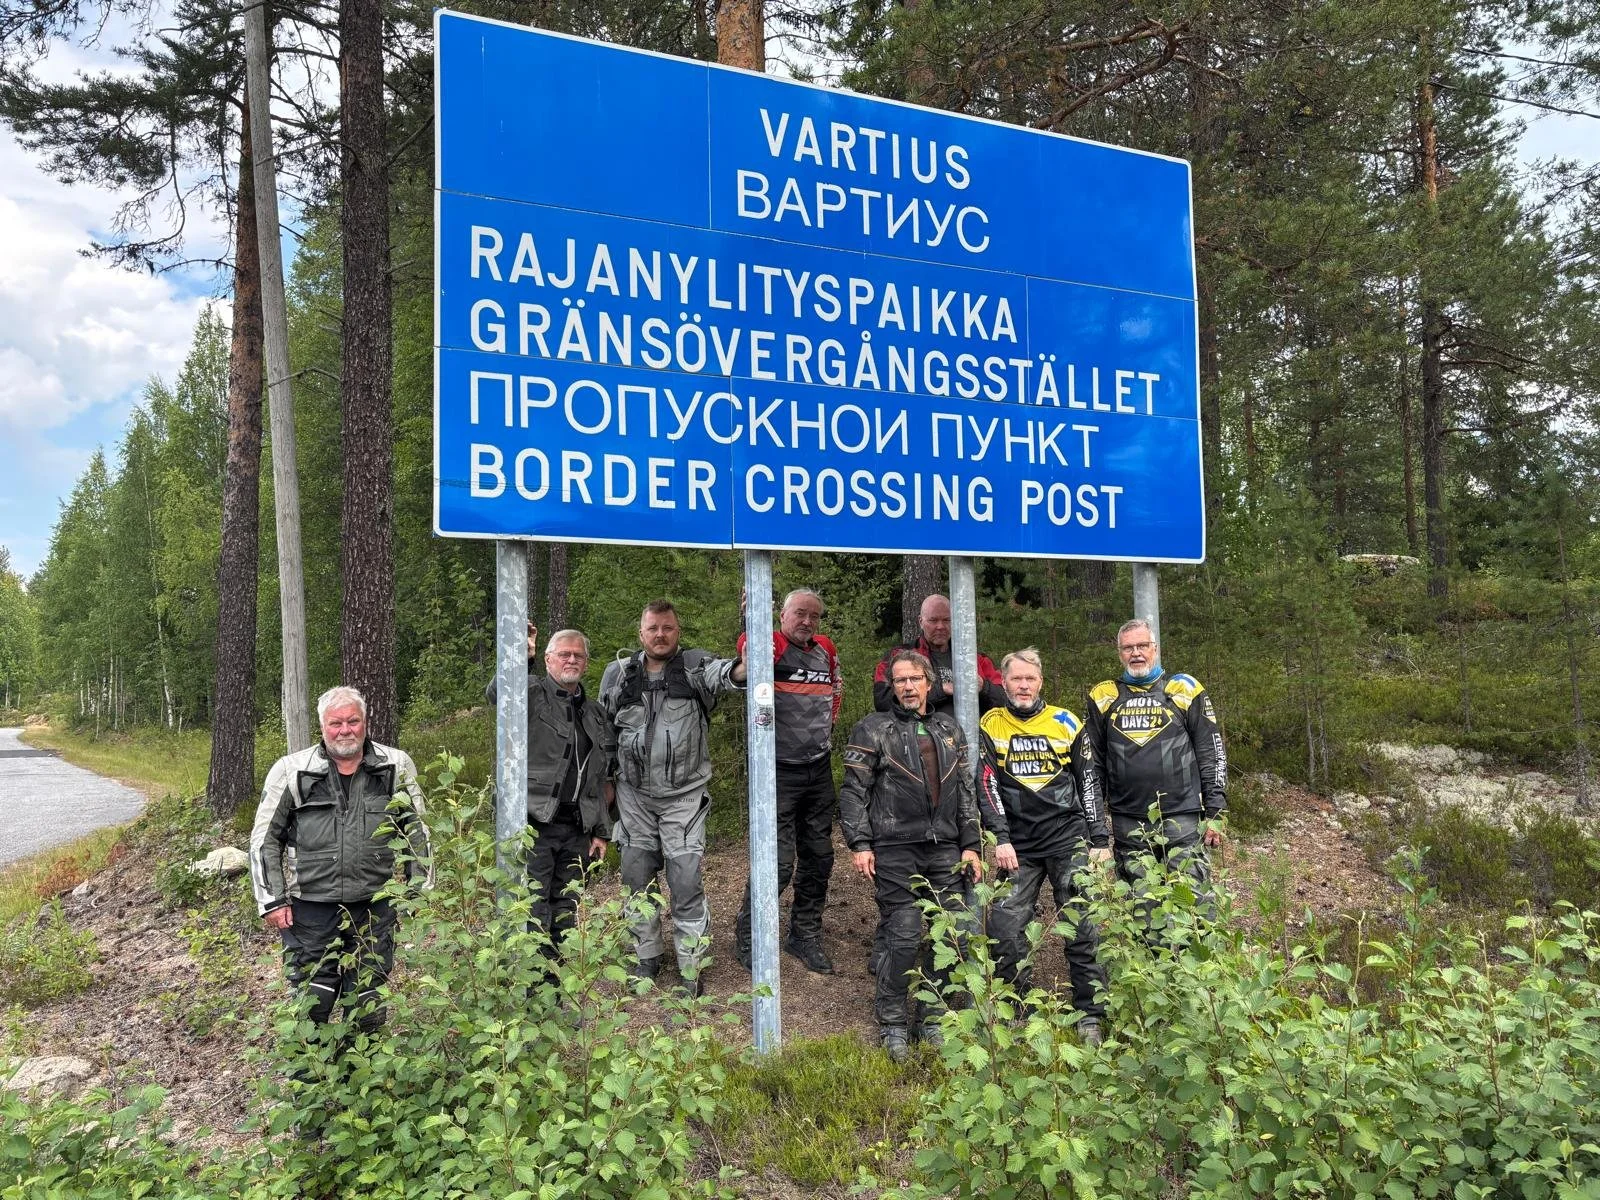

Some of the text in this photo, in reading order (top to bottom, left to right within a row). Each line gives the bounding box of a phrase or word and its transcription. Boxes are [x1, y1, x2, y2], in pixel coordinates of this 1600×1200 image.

[759, 108, 970, 190] VARTIUS
[737, 169, 990, 253] ВАРТИУС
[470, 225, 1018, 343] RAJANYLITYSPAIKKA
[470, 298, 1160, 416] GRÄNSÖVERGÅNGSSTÄLLET
[931, 412, 1100, 468] ПУНКТ
[470, 443, 1123, 529] BORDER CROSSING POST
[1012, 737, 1048, 752] MOTO
[1119, 706, 1163, 716] ADVENTUR
[1009, 751, 1056, 762] ADVENTURE
